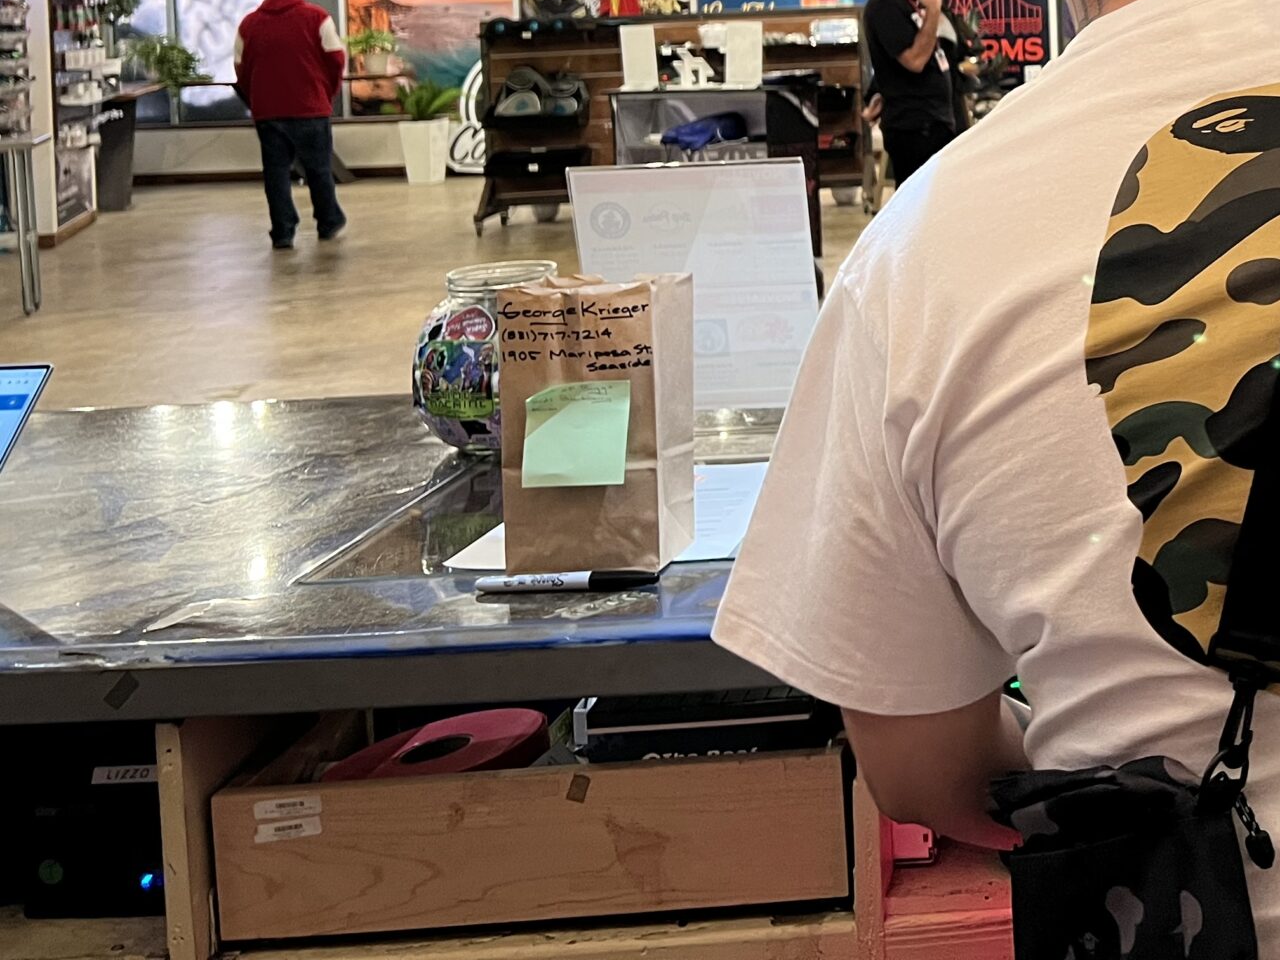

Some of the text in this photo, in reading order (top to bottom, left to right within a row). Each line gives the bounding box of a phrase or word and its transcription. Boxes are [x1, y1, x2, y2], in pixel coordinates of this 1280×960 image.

[498, 301, 577, 324] George
[581, 300, 650, 320] Krieger
[105, 767, 150, 780] LIZZO
